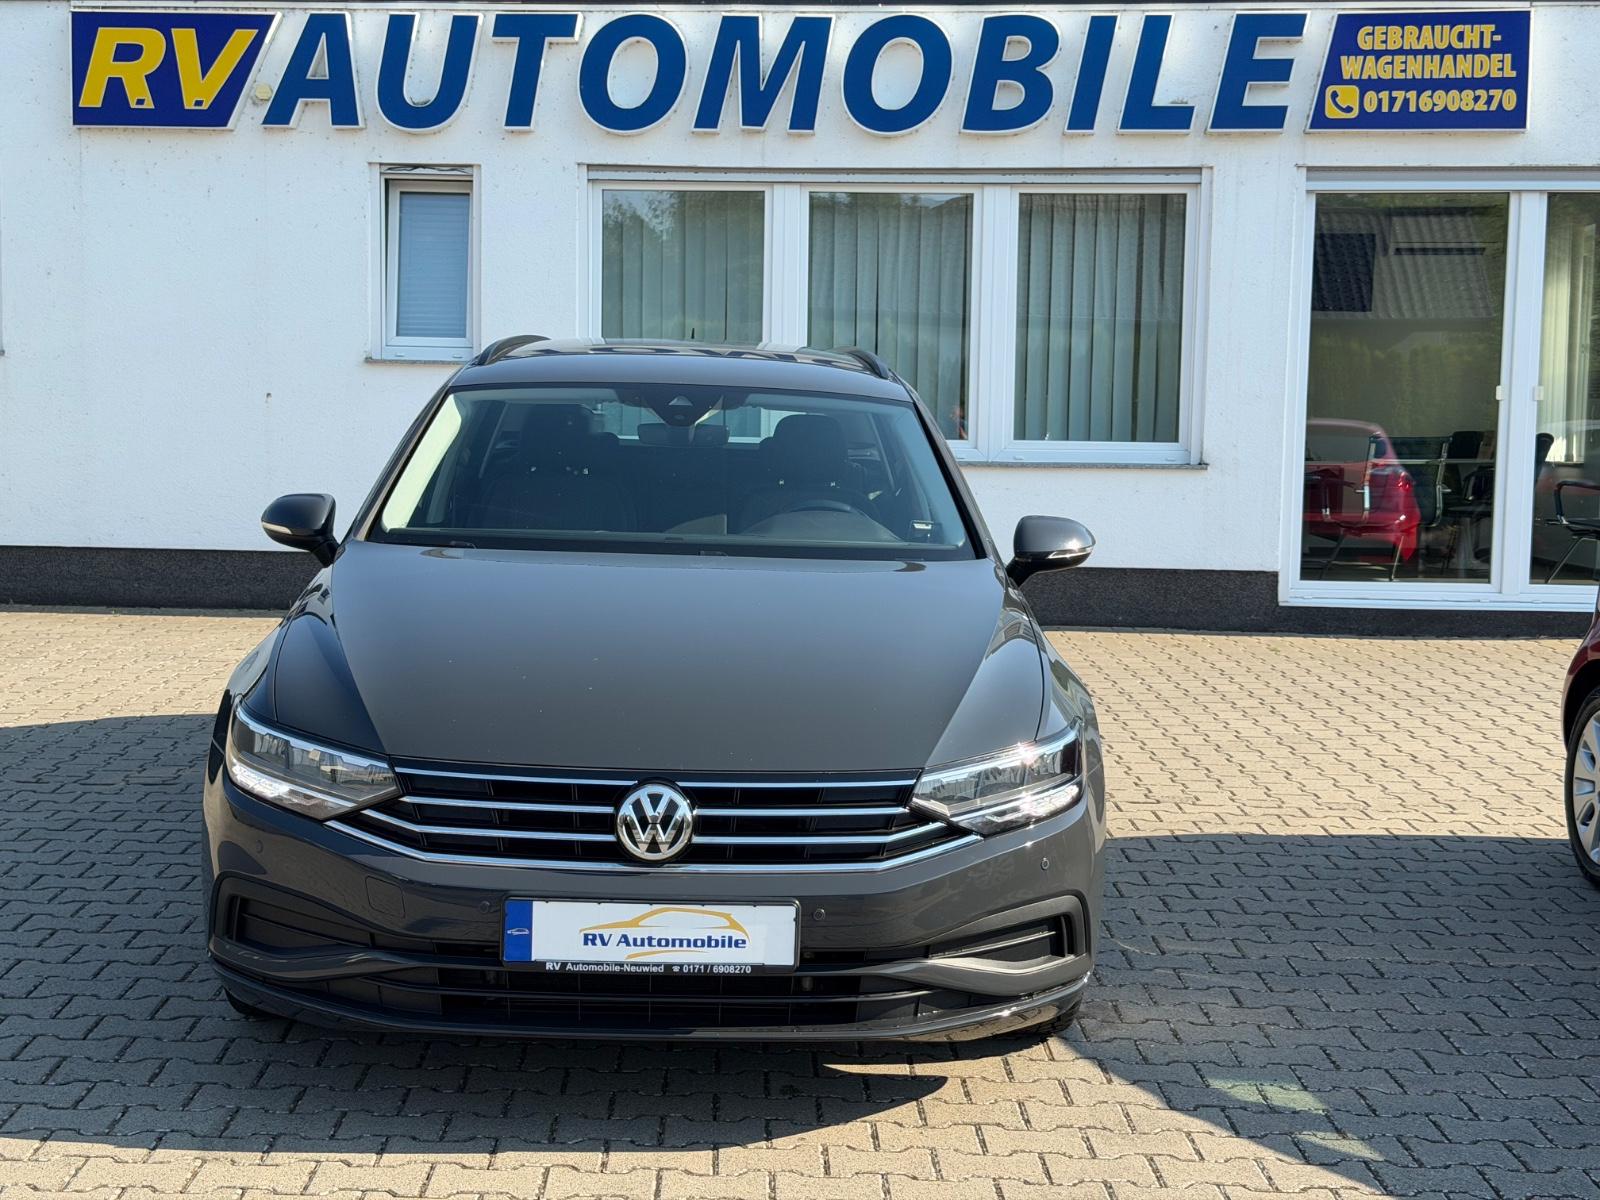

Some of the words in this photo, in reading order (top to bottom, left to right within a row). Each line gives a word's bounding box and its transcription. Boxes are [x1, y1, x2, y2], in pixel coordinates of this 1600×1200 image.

[1356, 24, 1502, 51] GEBRAUCHT-
[79, 26, 259, 110] RV
[262, 12, 1308, 135] AUTOMOBILE
[1340, 54, 1517, 80] WAGENHANDEL
[1363, 88, 1518, 113] 01716908270
[583, 933, 612, 947] RV
[616, 933, 747, 949] Automobile
[546, 962, 561, 971] RV
[565, 962, 665, 973] Automobile-Neuwied
[683, 963, 706, 973] 0171
[713, 963, 752, 974] 6908270
